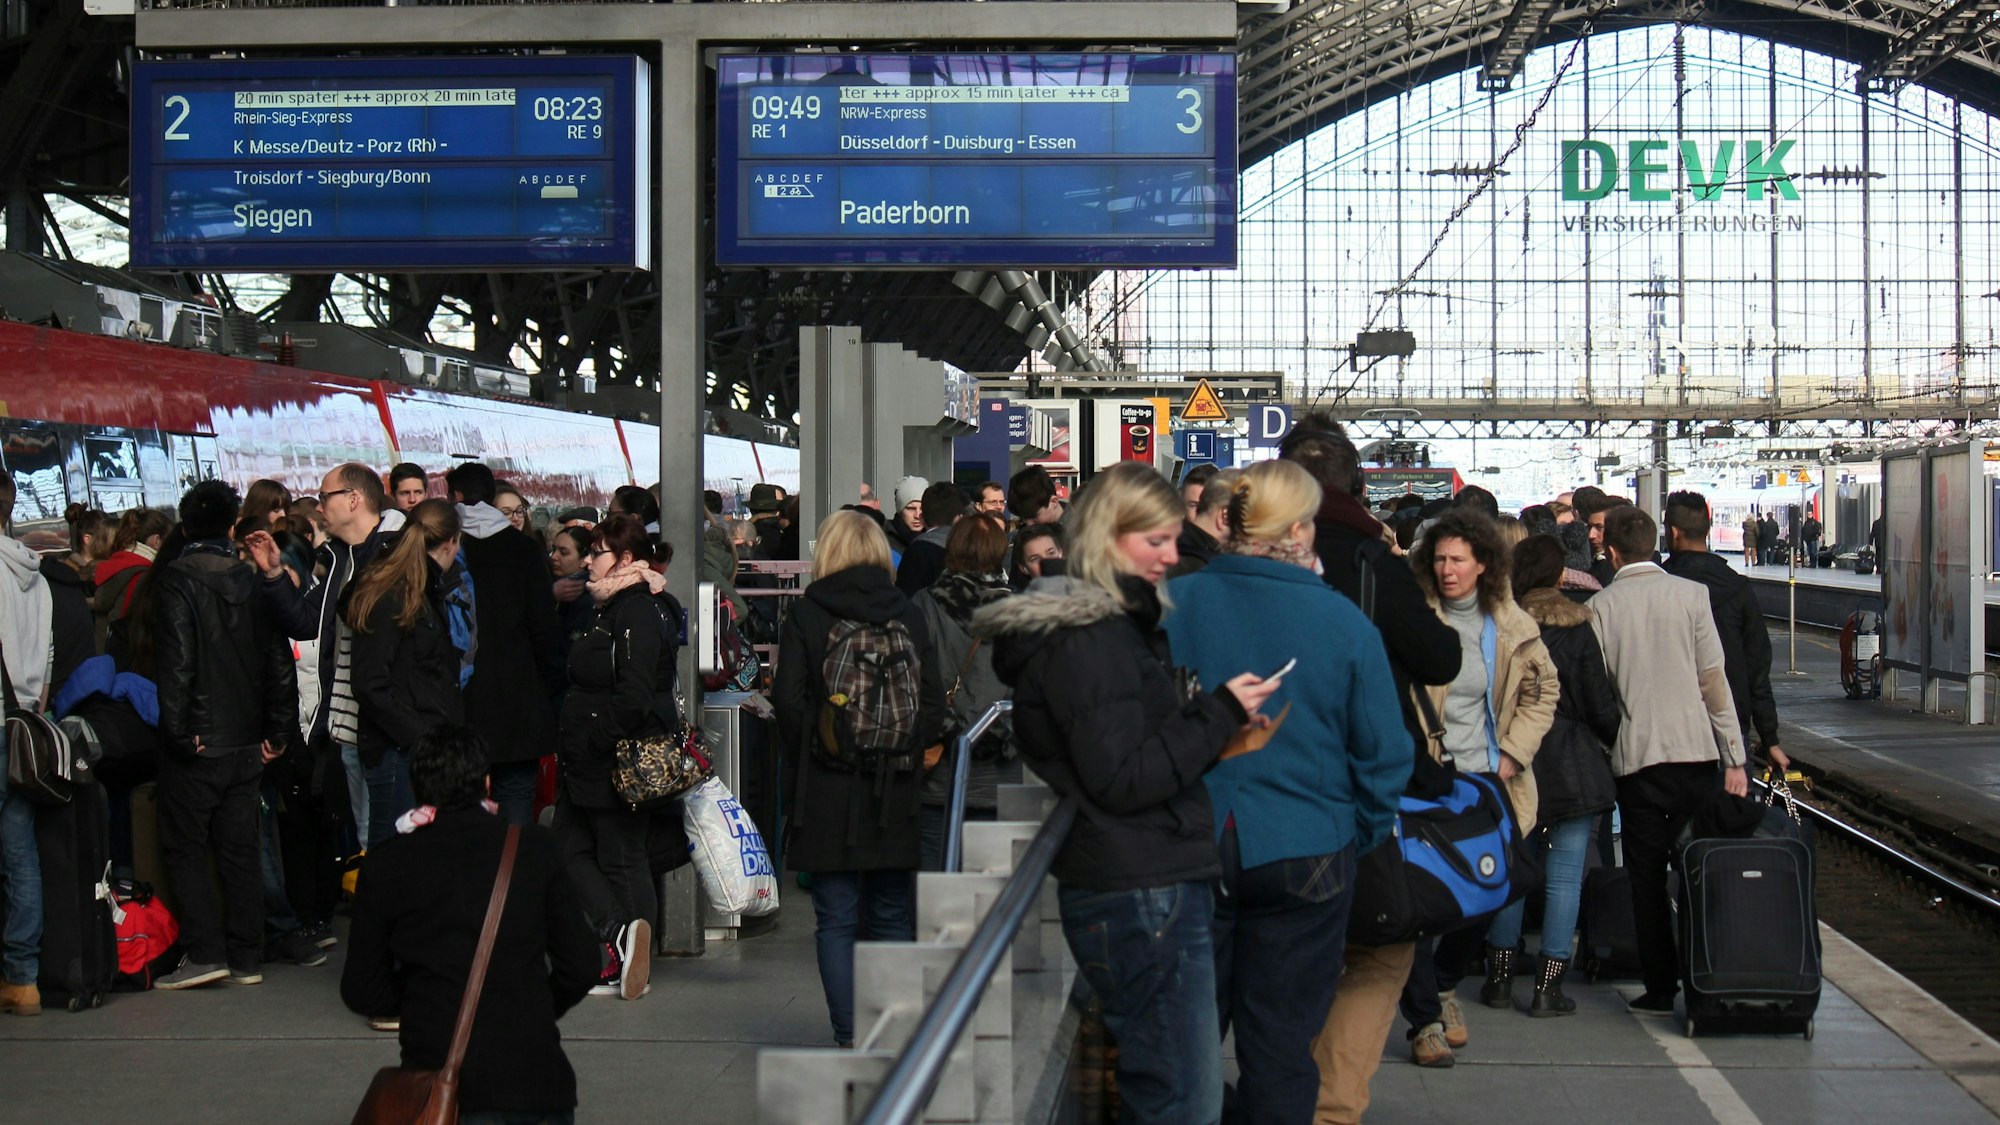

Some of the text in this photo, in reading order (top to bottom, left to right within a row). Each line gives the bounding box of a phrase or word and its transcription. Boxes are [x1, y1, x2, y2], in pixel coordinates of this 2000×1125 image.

[237, 92, 254, 105] 20
[258, 91, 284, 104] min
[288, 92, 339, 107] später
[344, 92, 371, 103] +++
[376, 90, 428, 105] approx
[434, 90, 450, 102] 20
[455, 90, 481, 102] min
[873, 89, 900, 98] +++
[905, 88, 960, 101] approx
[967, 87, 982, 98] 15
[987, 87, 1013, 98] min
[1018, 86, 1057, 98] later
[1068, 88, 1096, 97] +++
[1101, 87, 1120, 98] ca
[535, 97, 601, 120] 08:23
[753, 96, 820, 119] 09:49
[841, 107, 926, 121] NRW-Express
[1177, 87, 1202, 133] 3
[165, 96, 189, 140] 2
[234, 111, 352, 126] Rhein-Sieg-Express
[568, 125, 601, 139] RE 9
[753, 124, 785, 138] RE 1
[234, 140, 243, 154] K
[250, 139, 353, 153] Messe/Deutz
[367, 138, 402, 153] Porz
[407, 138, 437, 154] (Rh)
[841, 135, 928, 149] Düsseldorf
[945, 135, 1012, 153] Duisburg
[1029, 135, 1075, 149] Essen
[754, 173, 823, 183] A B C D E F
[1561, 140, 1801, 200] DEVK
[234, 171, 302, 184] Troisdorf
[318, 170, 430, 188] Siegburg/Bonn
[519, 174, 587, 185] A B C D E F
[233, 204, 311, 233] Siegen
[841, 201, 969, 223] Paderborn
[1562, 215, 1803, 232] VERSICHERUNGEN
[1122, 408, 1152, 418] Coffee-to-go
[1263, 406, 1287, 438] D
[1223, 443, 1229, 452] 3
